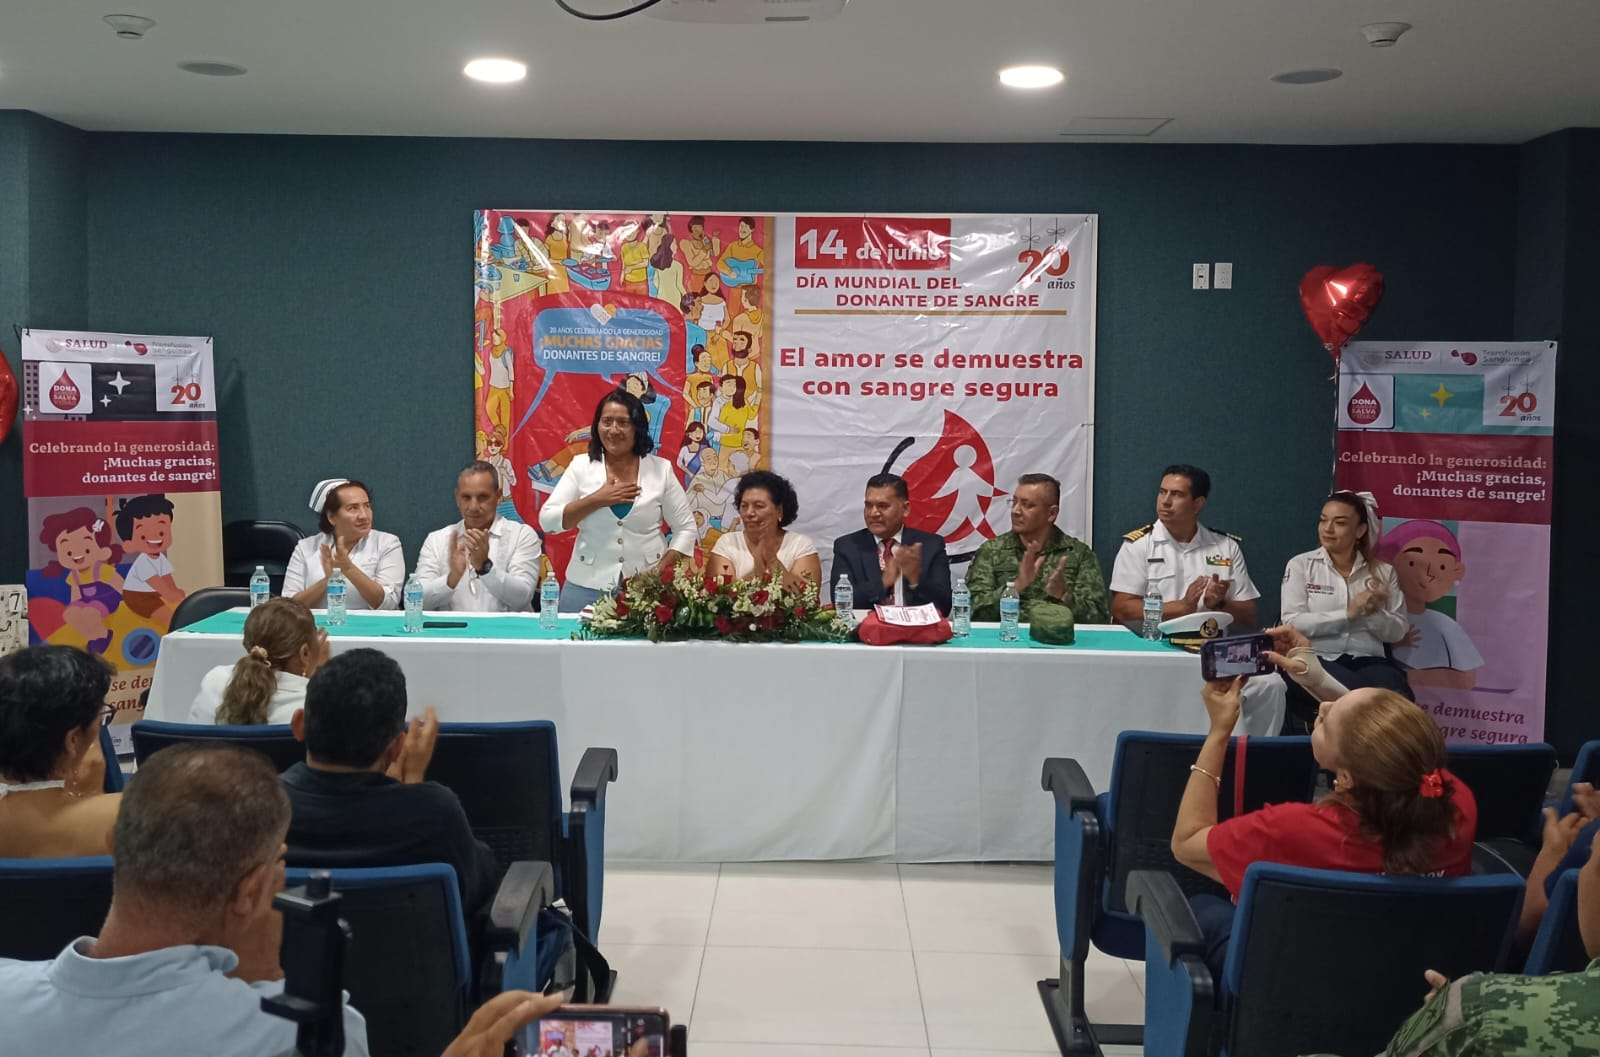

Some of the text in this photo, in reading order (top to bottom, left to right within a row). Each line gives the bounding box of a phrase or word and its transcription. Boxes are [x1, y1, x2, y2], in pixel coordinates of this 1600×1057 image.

[800, 228, 941, 263] 14 de junio
[1018, 244, 1070, 283] 20
[796, 273, 962, 290] DÍA MUNDIAL DEL
[1047, 278, 1076, 290] años
[836, 294, 1039, 308] DONANTE DE SANGRE
[65, 338, 108, 349] SALUD
[605, 337, 664, 350] GRACIAS
[543, 350, 661, 362] DONANTES DE SANGRE!
[780, 348, 1083, 369] El amor se demuestra
[1385, 351, 1432, 360] SALUD
[171, 382, 201, 405] 20
[802, 381, 1059, 402] con sangre segura
[1499, 392, 1537, 416] 20
[29, 440, 215, 455] Celebrando la generosidad:
[103, 454, 215, 471] ¡Muchas gracias,
[1429, 454, 1443, 466] la
[1447, 456, 1547, 469] generosidad:
[82, 469, 216, 483] donantes de sangre!
[1417, 471, 1546, 486] ¡Muchas gracias,
[1393, 484, 1546, 503] donantes de sangre!
[111, 680, 126, 691] se
[1433, 702, 1525, 725] demuestra
[1470, 729, 1529, 745] segura
